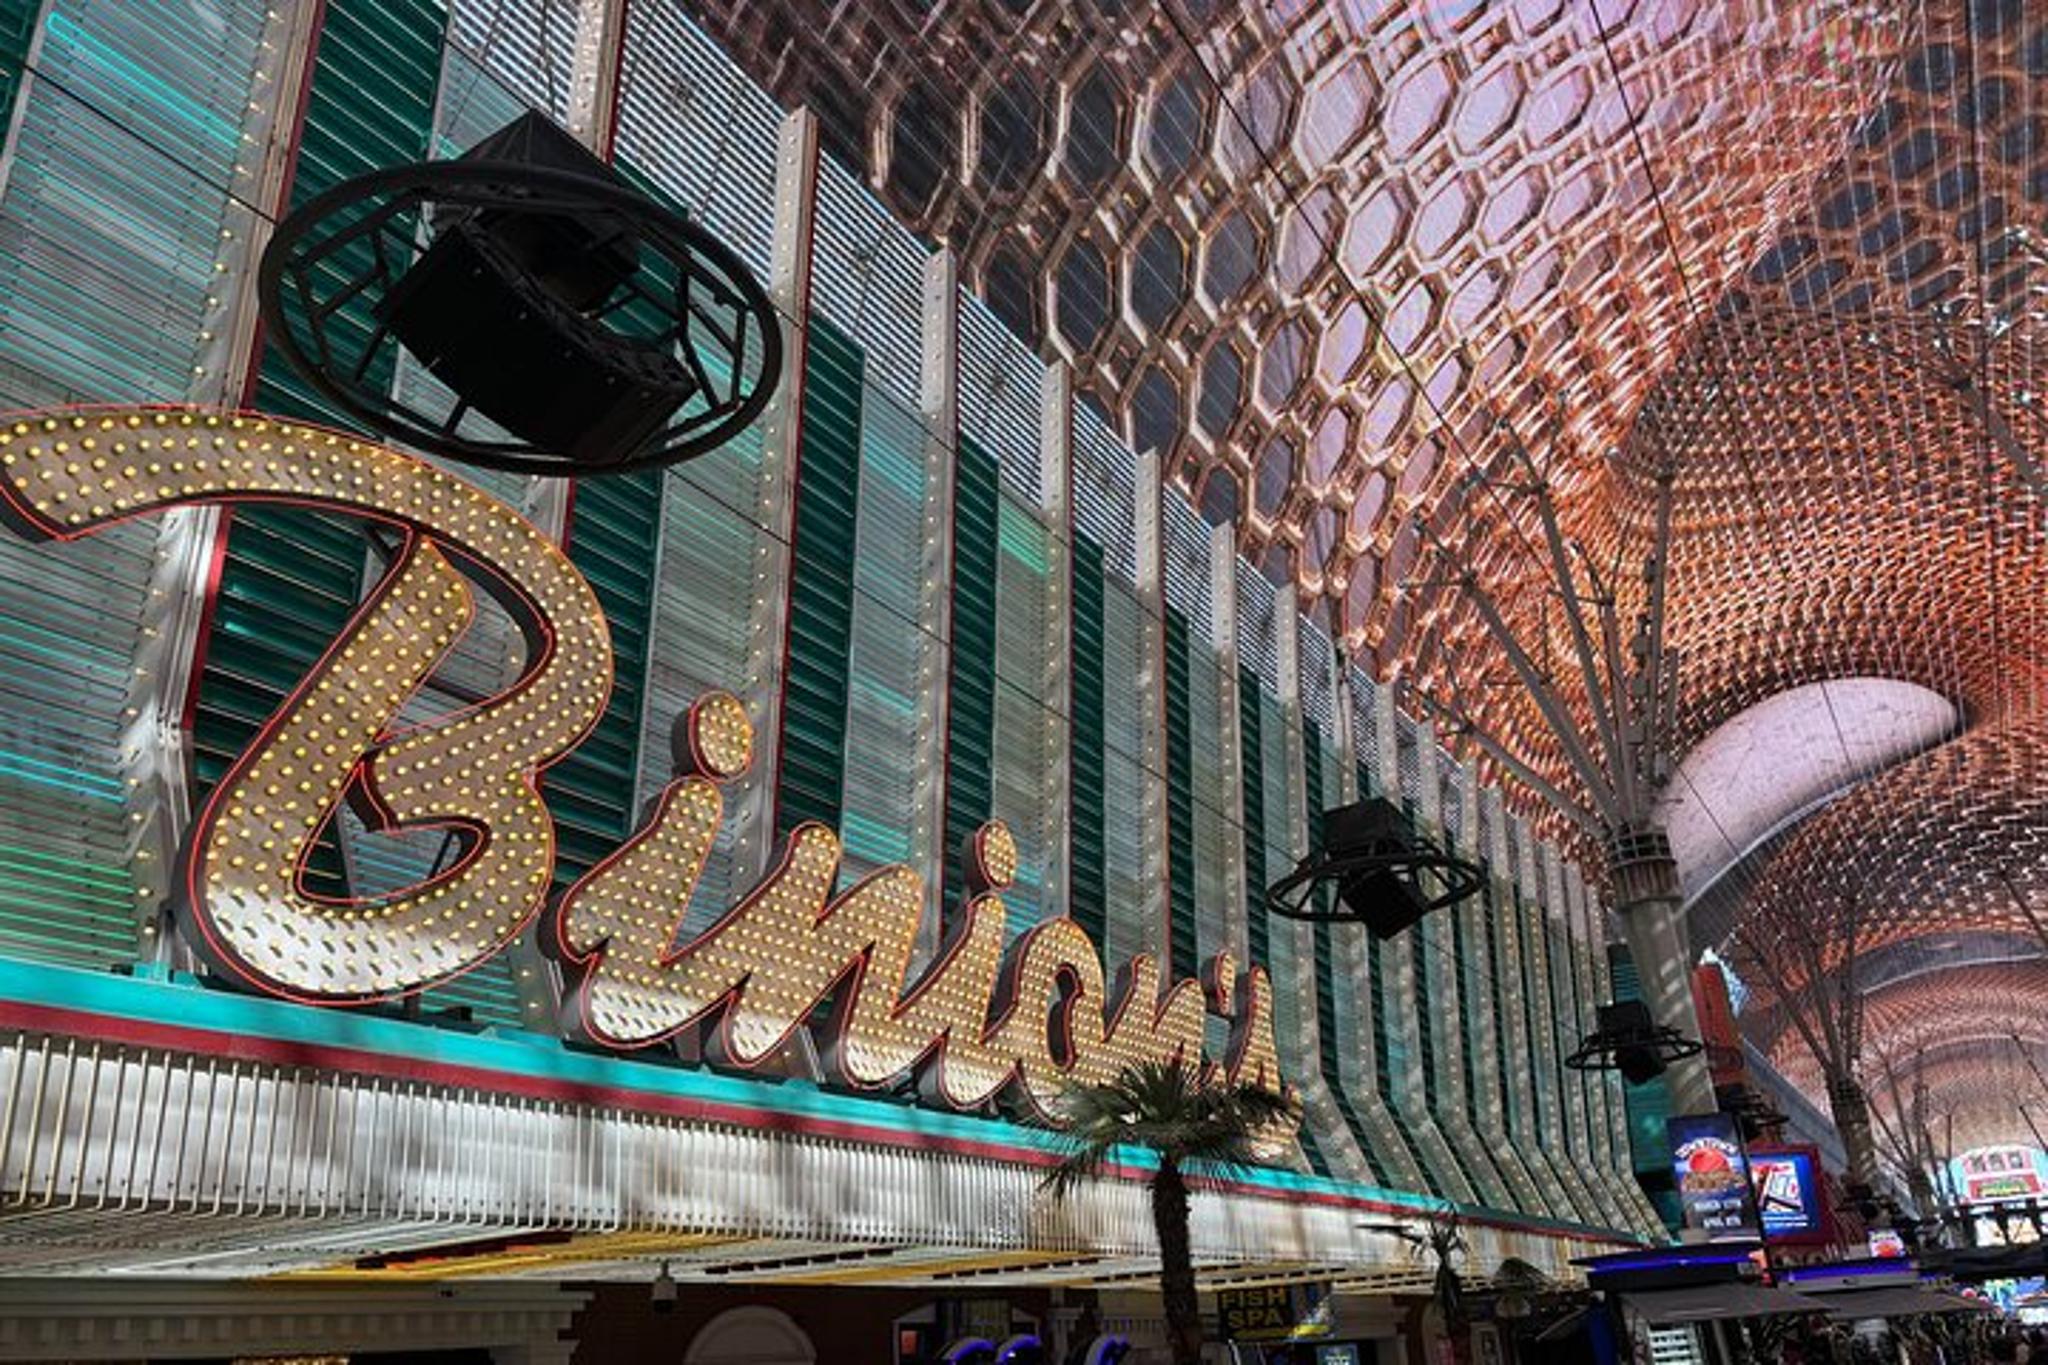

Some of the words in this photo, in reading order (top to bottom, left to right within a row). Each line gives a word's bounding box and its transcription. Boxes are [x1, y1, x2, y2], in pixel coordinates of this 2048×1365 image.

[0, 402, 1303, 1164] Binion's
[1221, 1287, 1287, 1309] FISH
[1228, 1309, 1284, 1328] SPA
